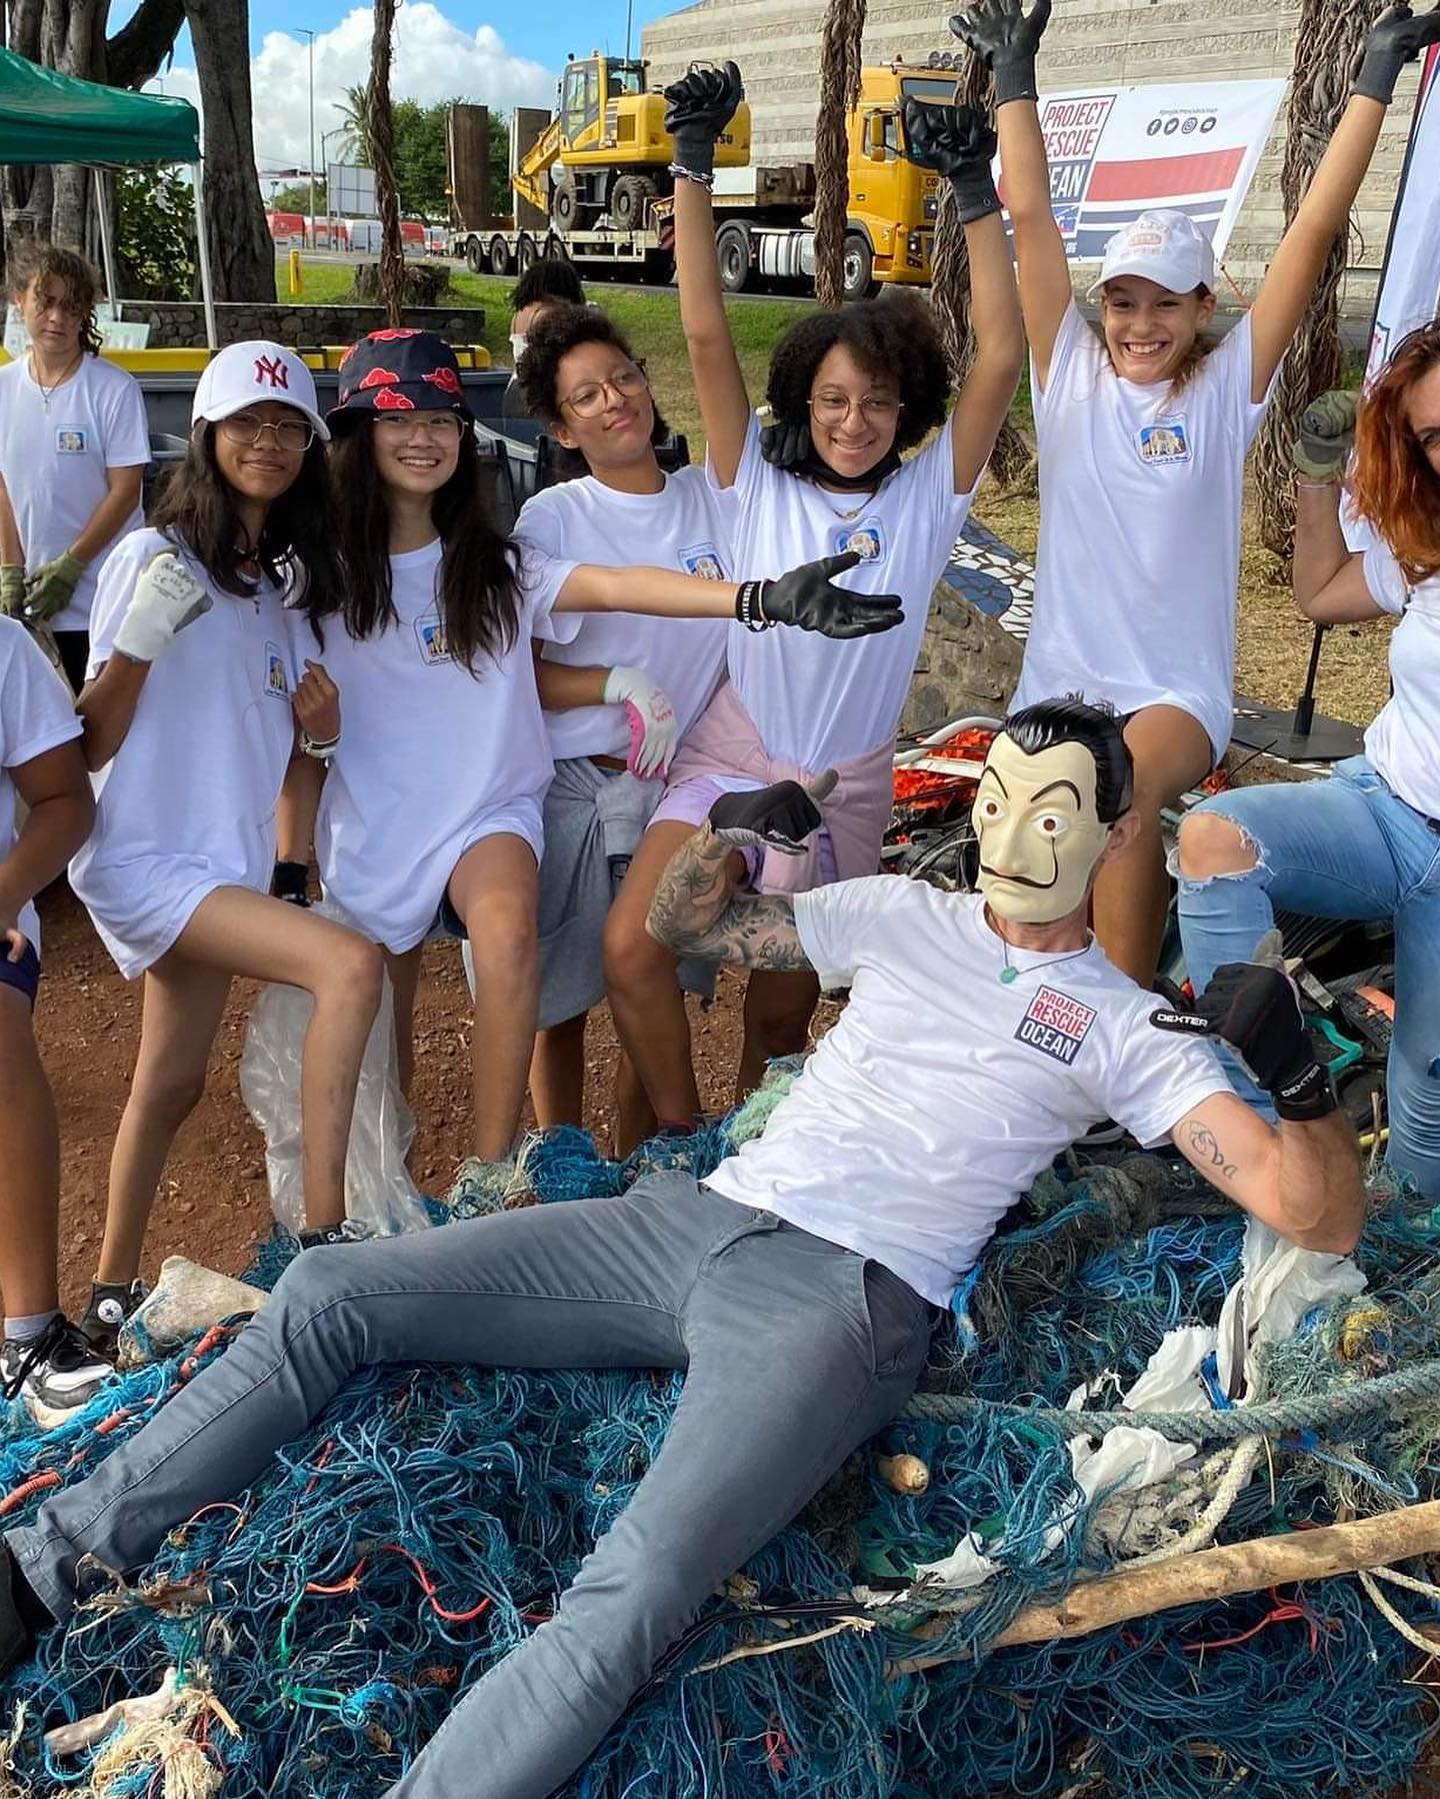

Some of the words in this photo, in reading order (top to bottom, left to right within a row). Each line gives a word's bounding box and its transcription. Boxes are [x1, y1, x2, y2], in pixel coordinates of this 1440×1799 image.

[1044, 101, 1110, 128] PROJECT
[1049, 164, 1086, 198] EAN
[254, 354, 289, 390] NY
[1030, 1001, 1087, 1038] RESCUE
[1040, 990, 1094, 1021] PROJECT
[1157, 1013, 1209, 1028] DEXTER
[1020, 1020, 1077, 1061] OCEAN
[1281, 1065, 1321, 1097] DEXTER
